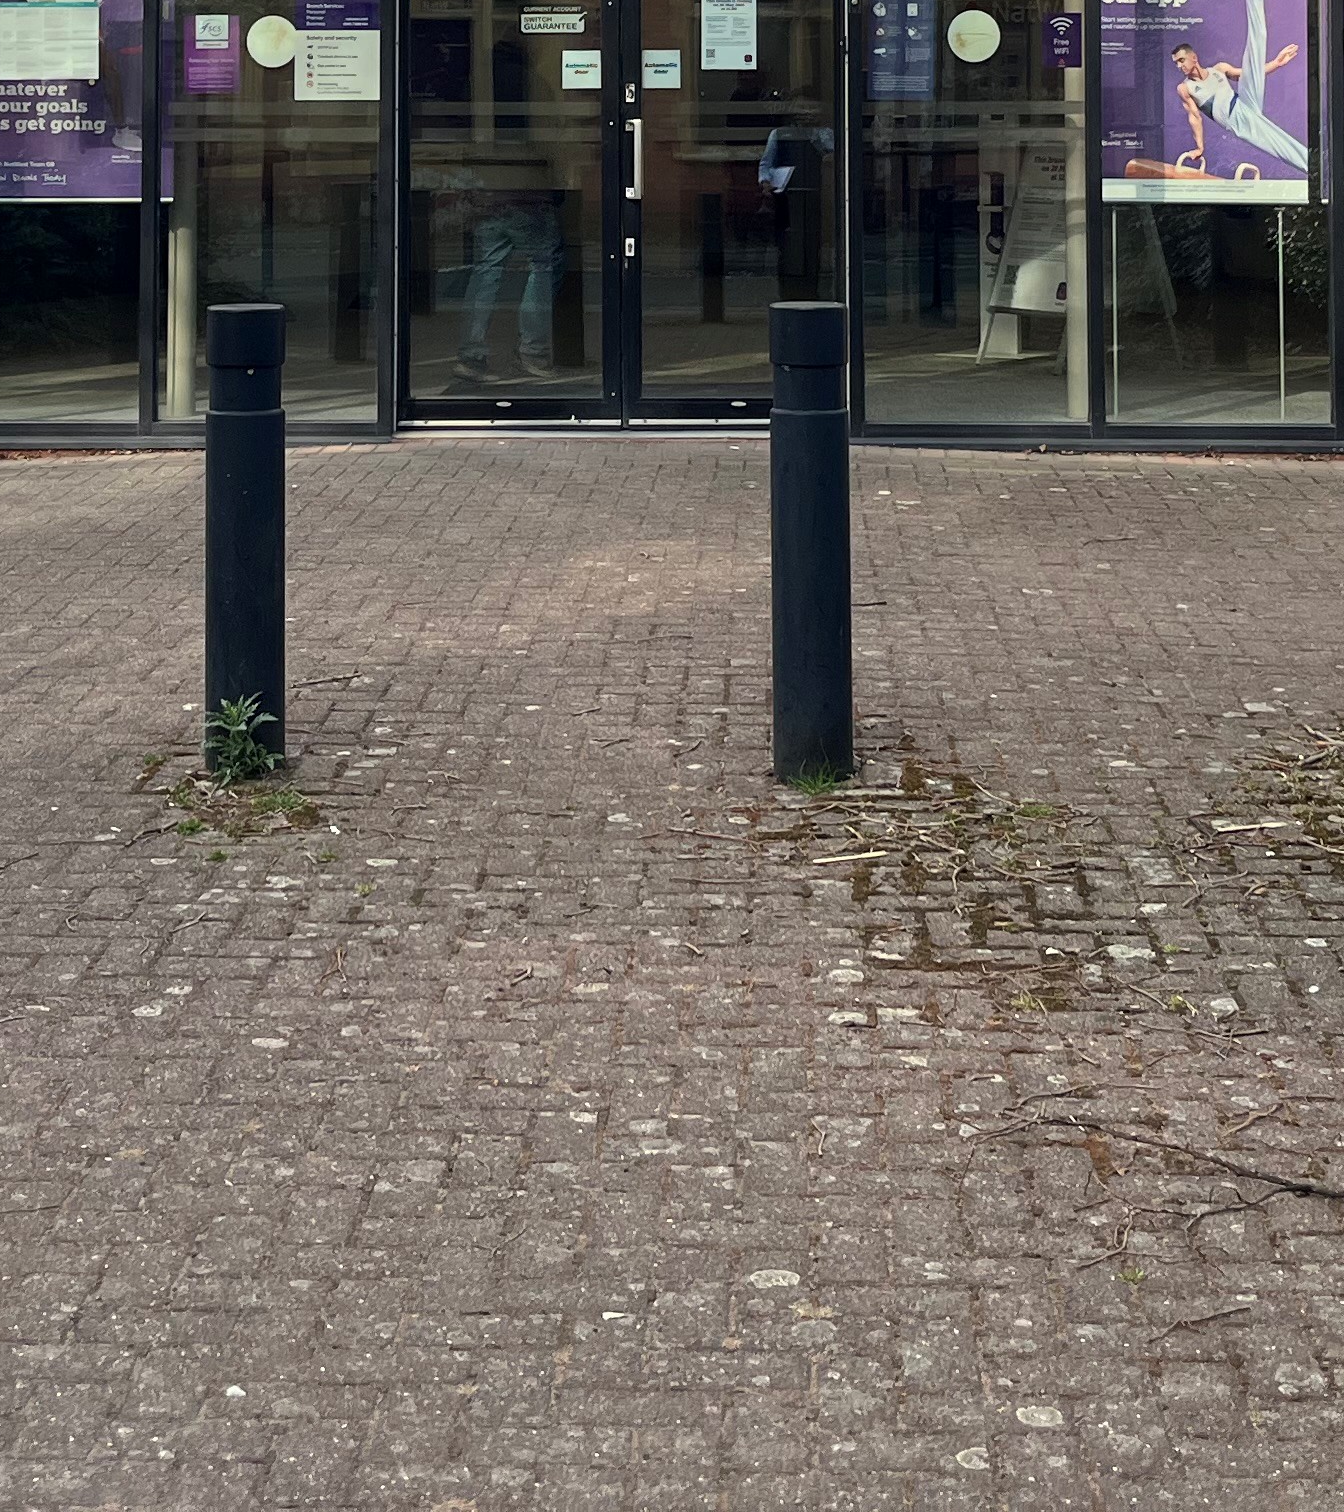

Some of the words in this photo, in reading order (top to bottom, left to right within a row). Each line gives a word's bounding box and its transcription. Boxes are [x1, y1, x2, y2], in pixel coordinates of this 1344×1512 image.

[523, 22, 578, 30] GUARANTEE
[1053, 38, 1070, 46] Free
[35, 99, 88, 116] goals
[15, 117, 46, 134] get
[50, 115, 107, 134] going
